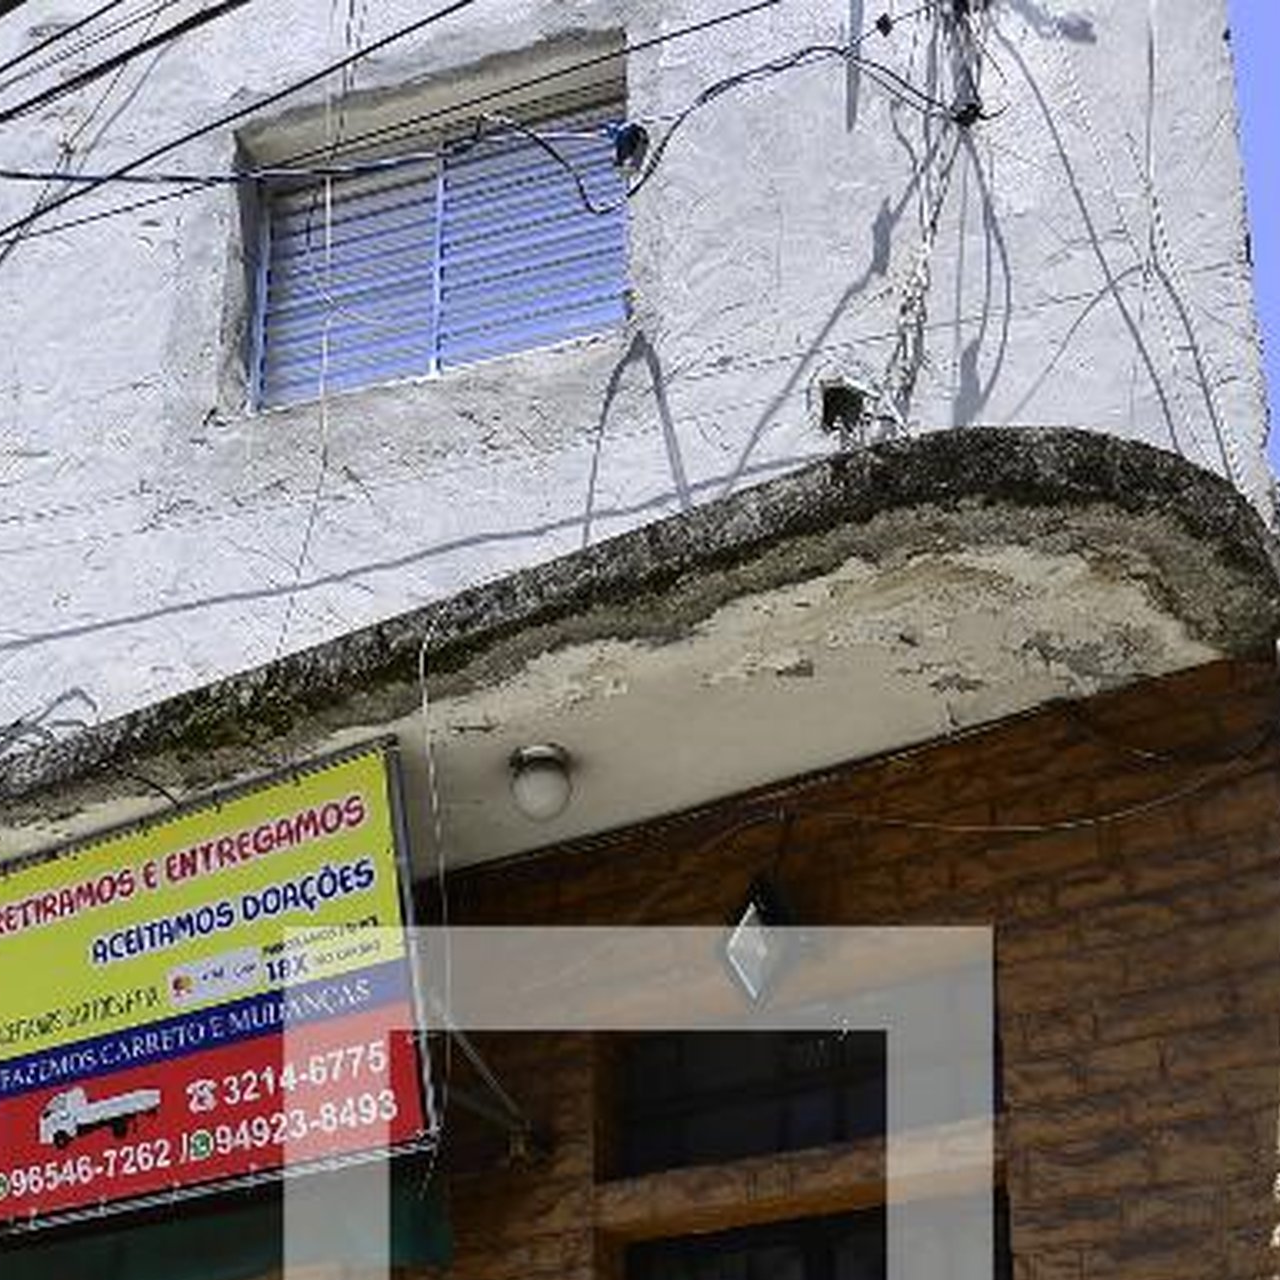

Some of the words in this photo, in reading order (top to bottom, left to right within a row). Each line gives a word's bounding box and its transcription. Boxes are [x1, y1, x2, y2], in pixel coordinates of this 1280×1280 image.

[142, 862, 159, 888] E
[165, 795, 366, 884] ENTREGAMOS
[91, 901, 235, 964] ACEITAMOS
[242, 858, 375, 922] DOAÇÕES
[0, 1044, 98, 1092] FAZEMOS
[100, 1014, 206, 1066] CARRETO
[208, 1012, 228, 1037] E
[230, 976, 373, 1035] MUDANÇAS
[223, 1039, 388, 1105] 3214-6775
[10, 1139, 172, 1197] 96546-7262
[215, 1090, 400, 1155] 94923-8493
